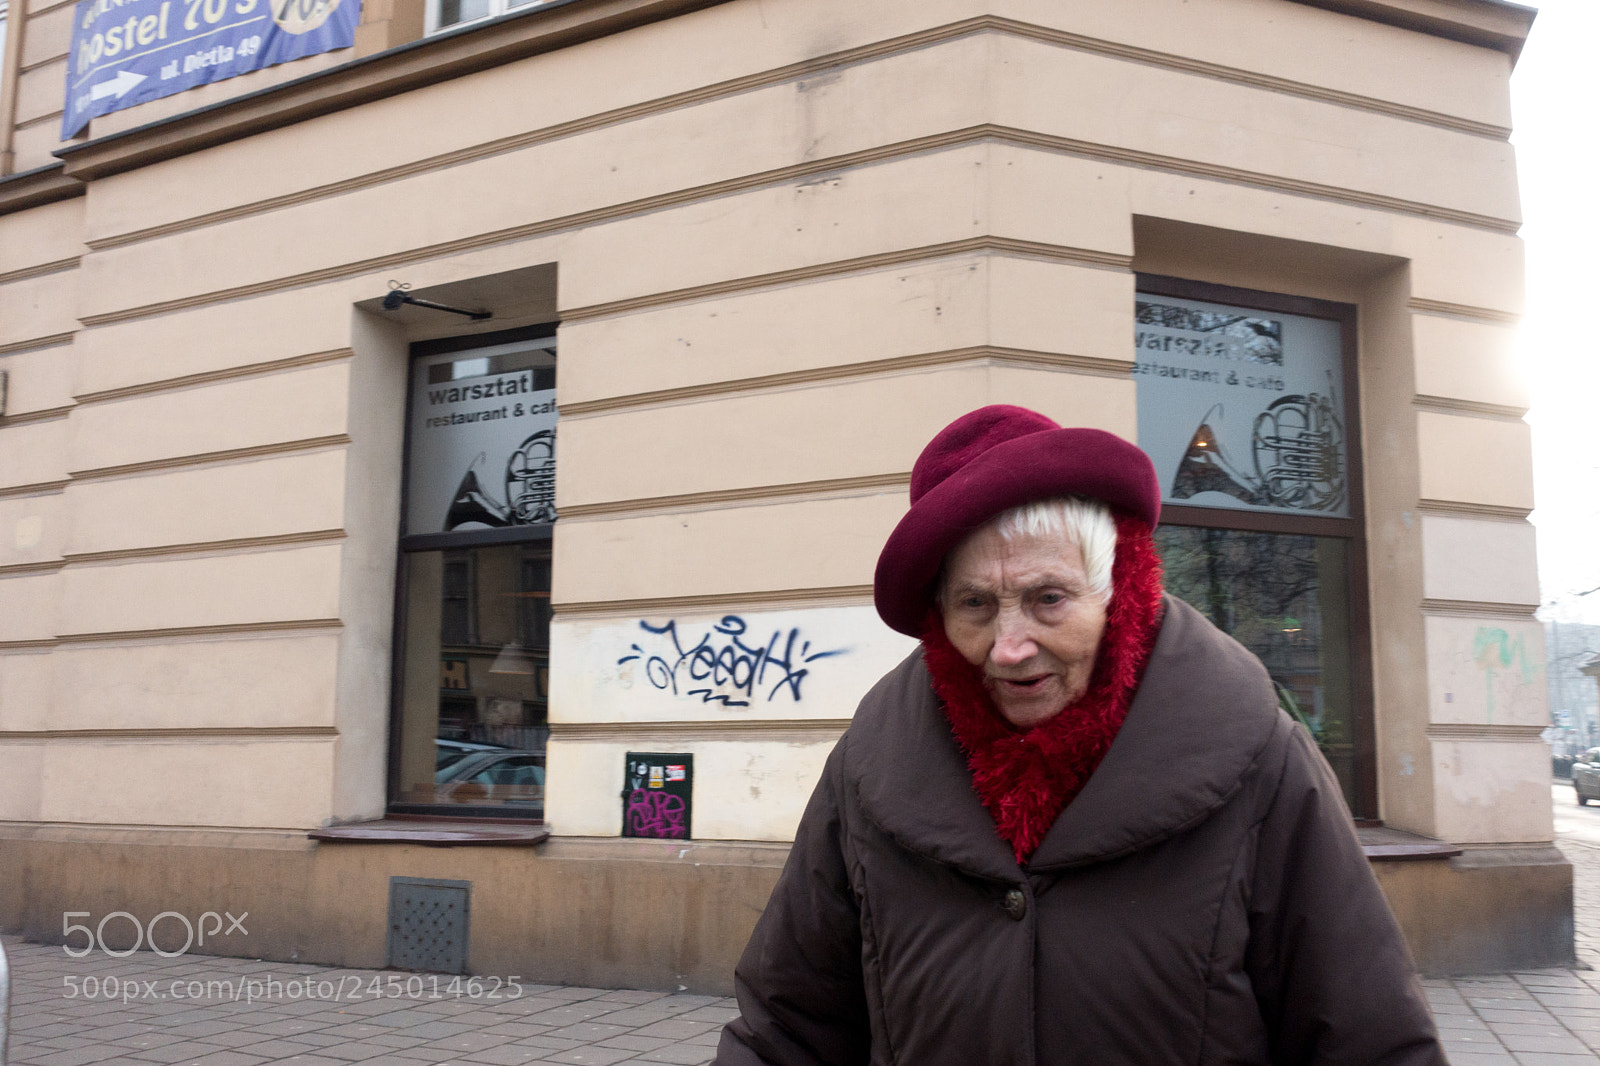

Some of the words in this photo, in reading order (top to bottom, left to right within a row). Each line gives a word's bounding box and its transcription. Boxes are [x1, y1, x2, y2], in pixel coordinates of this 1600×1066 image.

[236, 35, 261, 57] 49
[1132, 361, 1220, 384] estaurant
[428, 374, 529, 405] warsztat
[426, 407, 508, 429] restaurant
[513, 403, 524, 417] &
[530, 398, 557, 416] caf
